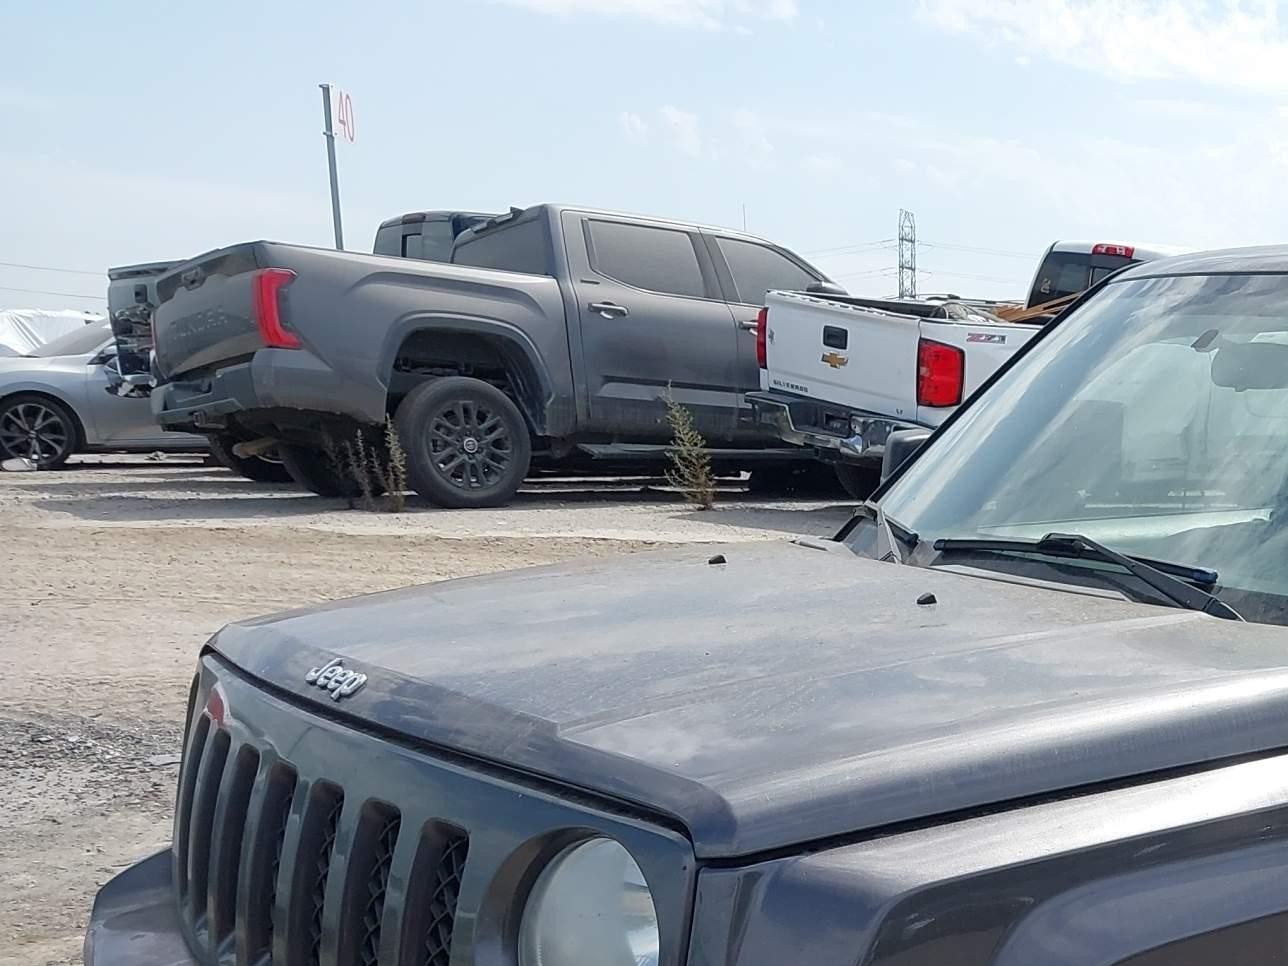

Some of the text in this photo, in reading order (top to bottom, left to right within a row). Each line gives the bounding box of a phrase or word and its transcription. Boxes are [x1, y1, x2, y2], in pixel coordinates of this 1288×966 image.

[338, 90, 355, 142] 40
[773, 379, 809, 393] SILVERADO
[305, 657, 368, 701] Jeep
